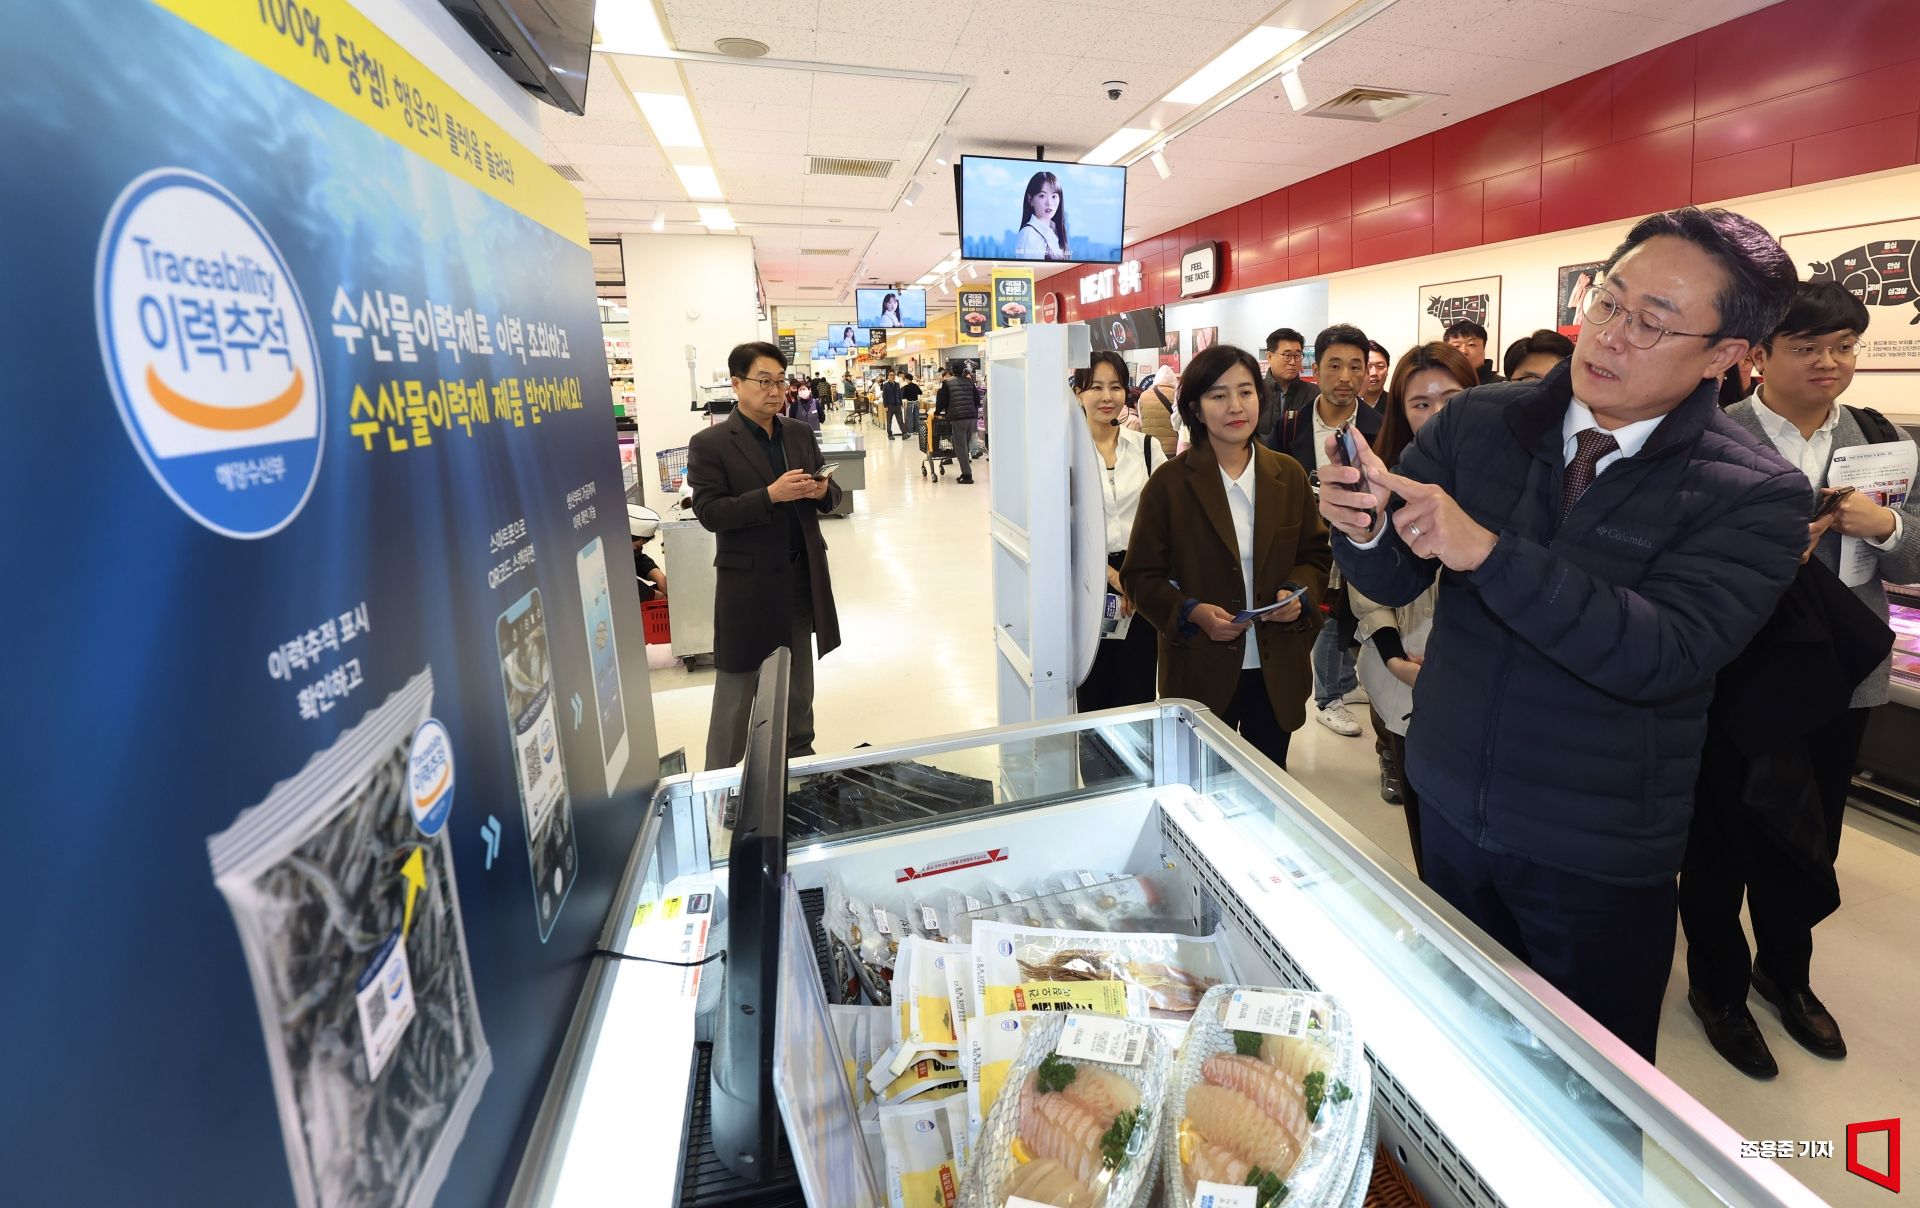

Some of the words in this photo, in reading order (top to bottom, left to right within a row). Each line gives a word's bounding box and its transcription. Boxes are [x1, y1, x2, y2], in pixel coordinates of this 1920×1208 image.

[256, 0, 330, 64] 100%
[335, 33, 390, 110] 당첨!
[393, 74, 442, 139] 행운의
[446, 112, 484, 172] 룰렛을
[132, 234, 276, 303] Traceability
[1184, 273, 1195, 283] THE
[1195, 270, 1210, 281] TASTE
[1190, 261, 1203, 272] FEEL
[1887, 262, 1901, 270] 안심
[1888, 287, 1907, 295] 삼겹살
[138, 294, 295, 373] 이력추적
[331, 284, 495, 364] 수산물이력제로
[496, 314, 528, 366] 이력
[527, 322, 571, 360] 조회하고
[350, 378, 490, 452] 수산물이력제
[492, 377, 525, 428] 제품
[524, 376, 583, 425] 받아가세요!
[215, 455, 288, 491] 해양수산부
[489, 518, 527, 554] 스마트폰으로
[1607, 528, 1652, 549] Columbia
[488, 558, 513, 589] QR코드
[512, 542, 536, 573] 스캔하면
[268, 618, 340, 681] 이력추적
[337, 602, 371, 643] 표시
[297, 658, 364, 720] 확인하고
